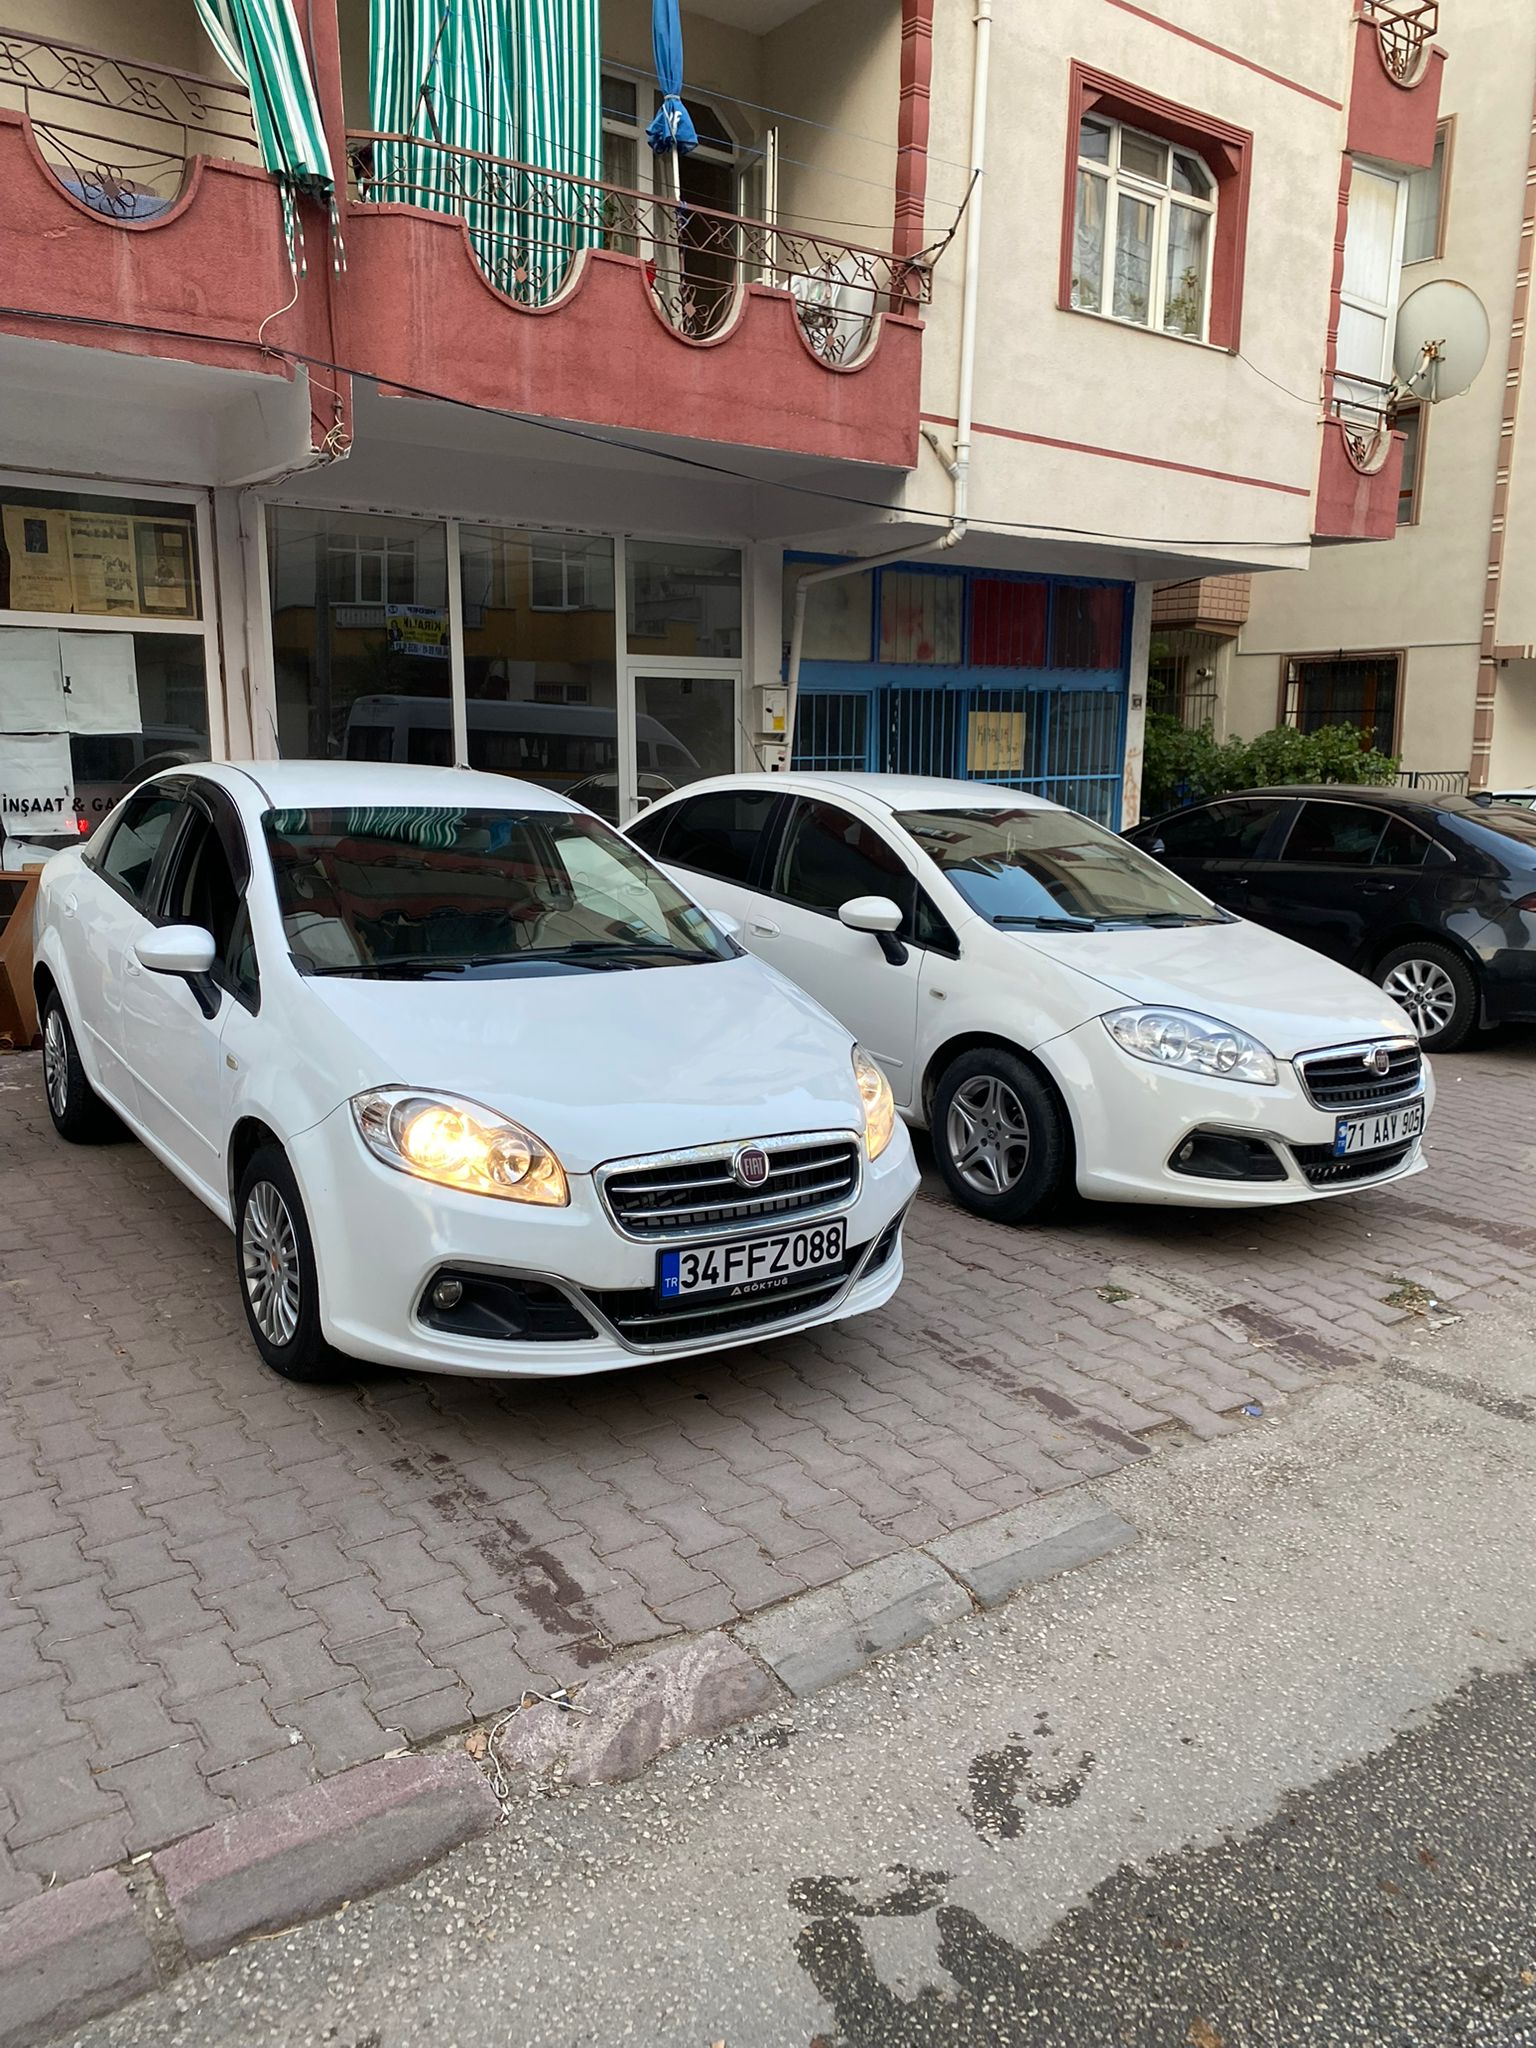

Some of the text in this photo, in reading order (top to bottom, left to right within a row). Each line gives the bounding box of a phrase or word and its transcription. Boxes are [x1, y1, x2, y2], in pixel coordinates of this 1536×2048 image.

[2, 794, 120, 817] İNŞAAT & GA
[1347, 1125, 1364, 1150] 71
[1374, 1117, 1397, 1144] AAY
[1402, 1109, 1420, 1135] 905
[743, 1156, 766, 1176] FIAT
[664, 1226, 841, 1290] TR 34FFZ088
